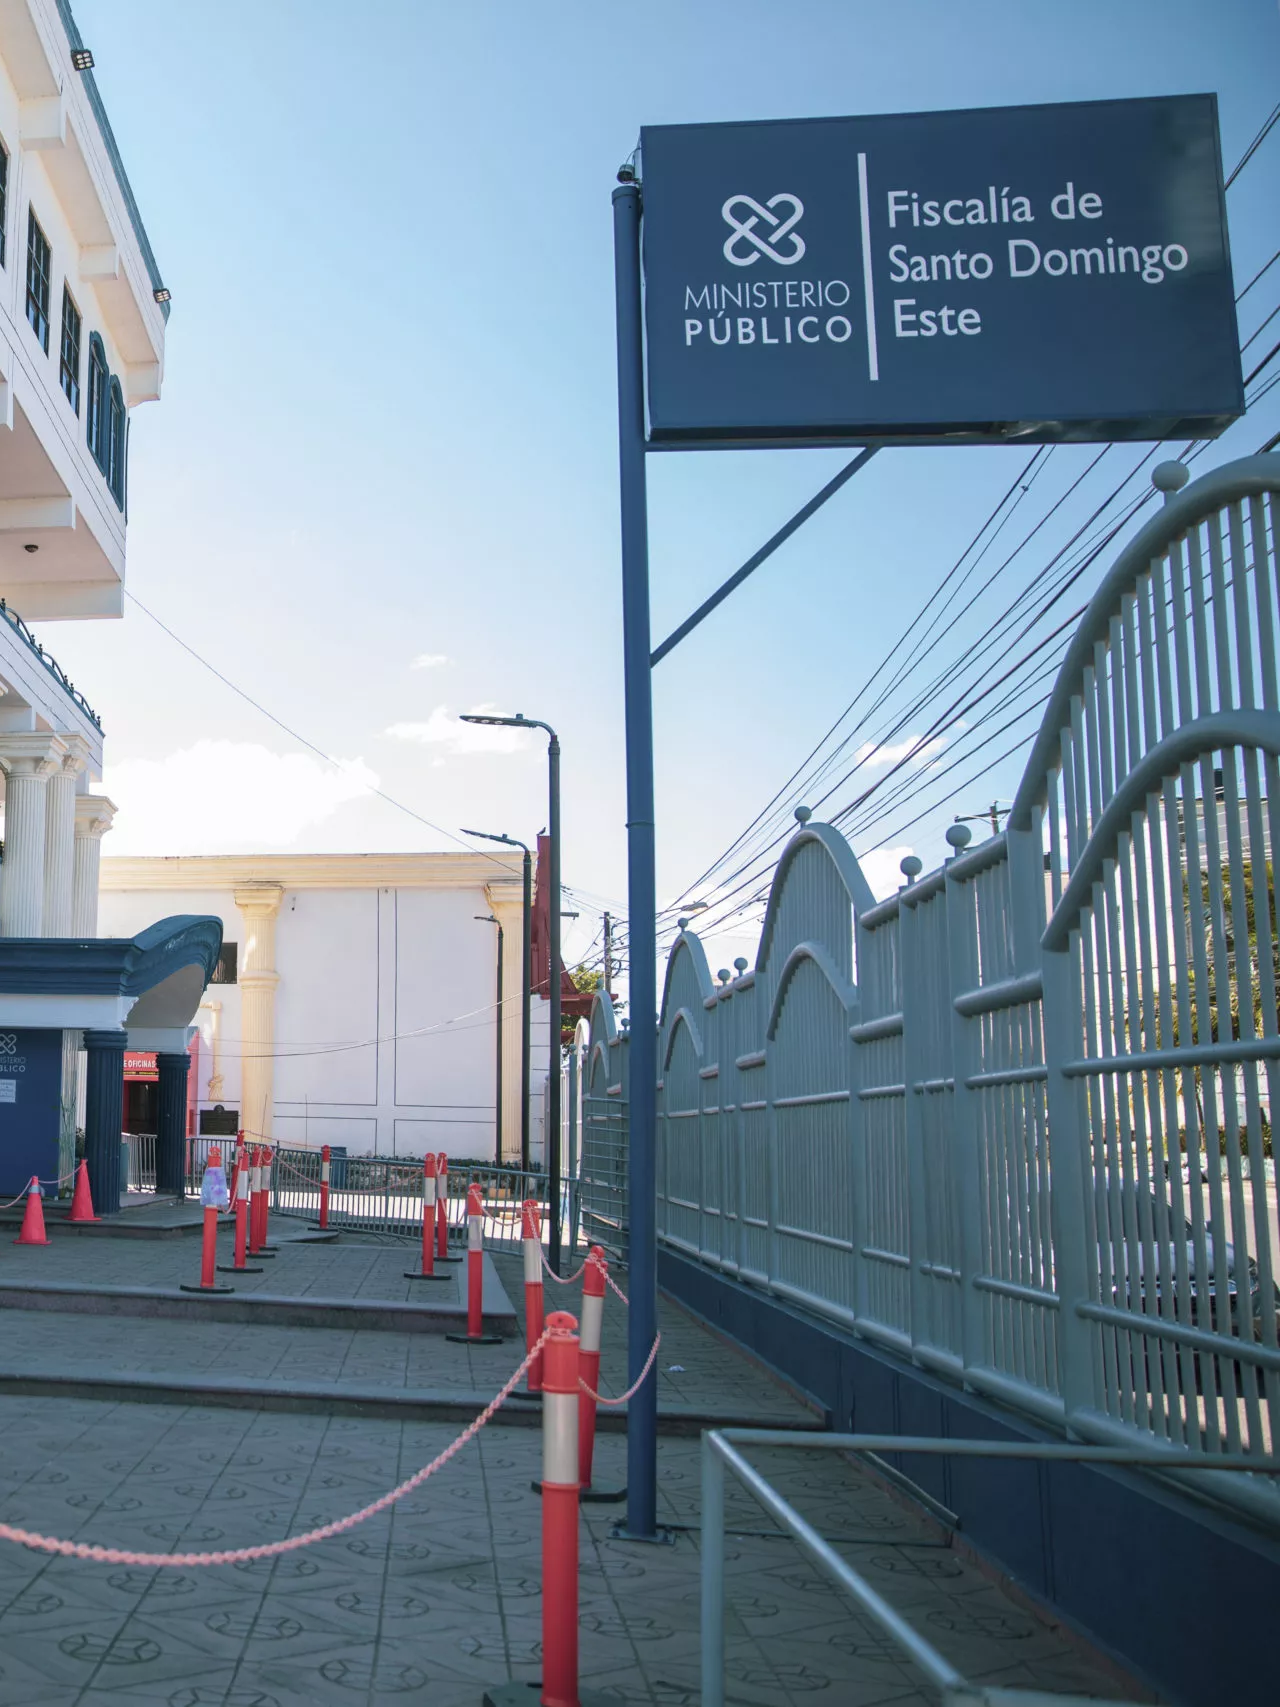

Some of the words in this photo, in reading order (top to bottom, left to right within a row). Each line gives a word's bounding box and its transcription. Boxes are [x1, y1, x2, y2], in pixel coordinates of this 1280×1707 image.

[887, 186, 1035, 228] Fiscalía
[1050, 182, 1103, 220] de
[888, 244, 994, 282] Santo
[1008, 237, 1189, 284] Domingo
[684, 280, 851, 310] MINISTERIO
[684, 310, 853, 346] PÚBLICO
[893, 298, 982, 337] Este
[128, 1060, 156, 1068] OFICINAS
